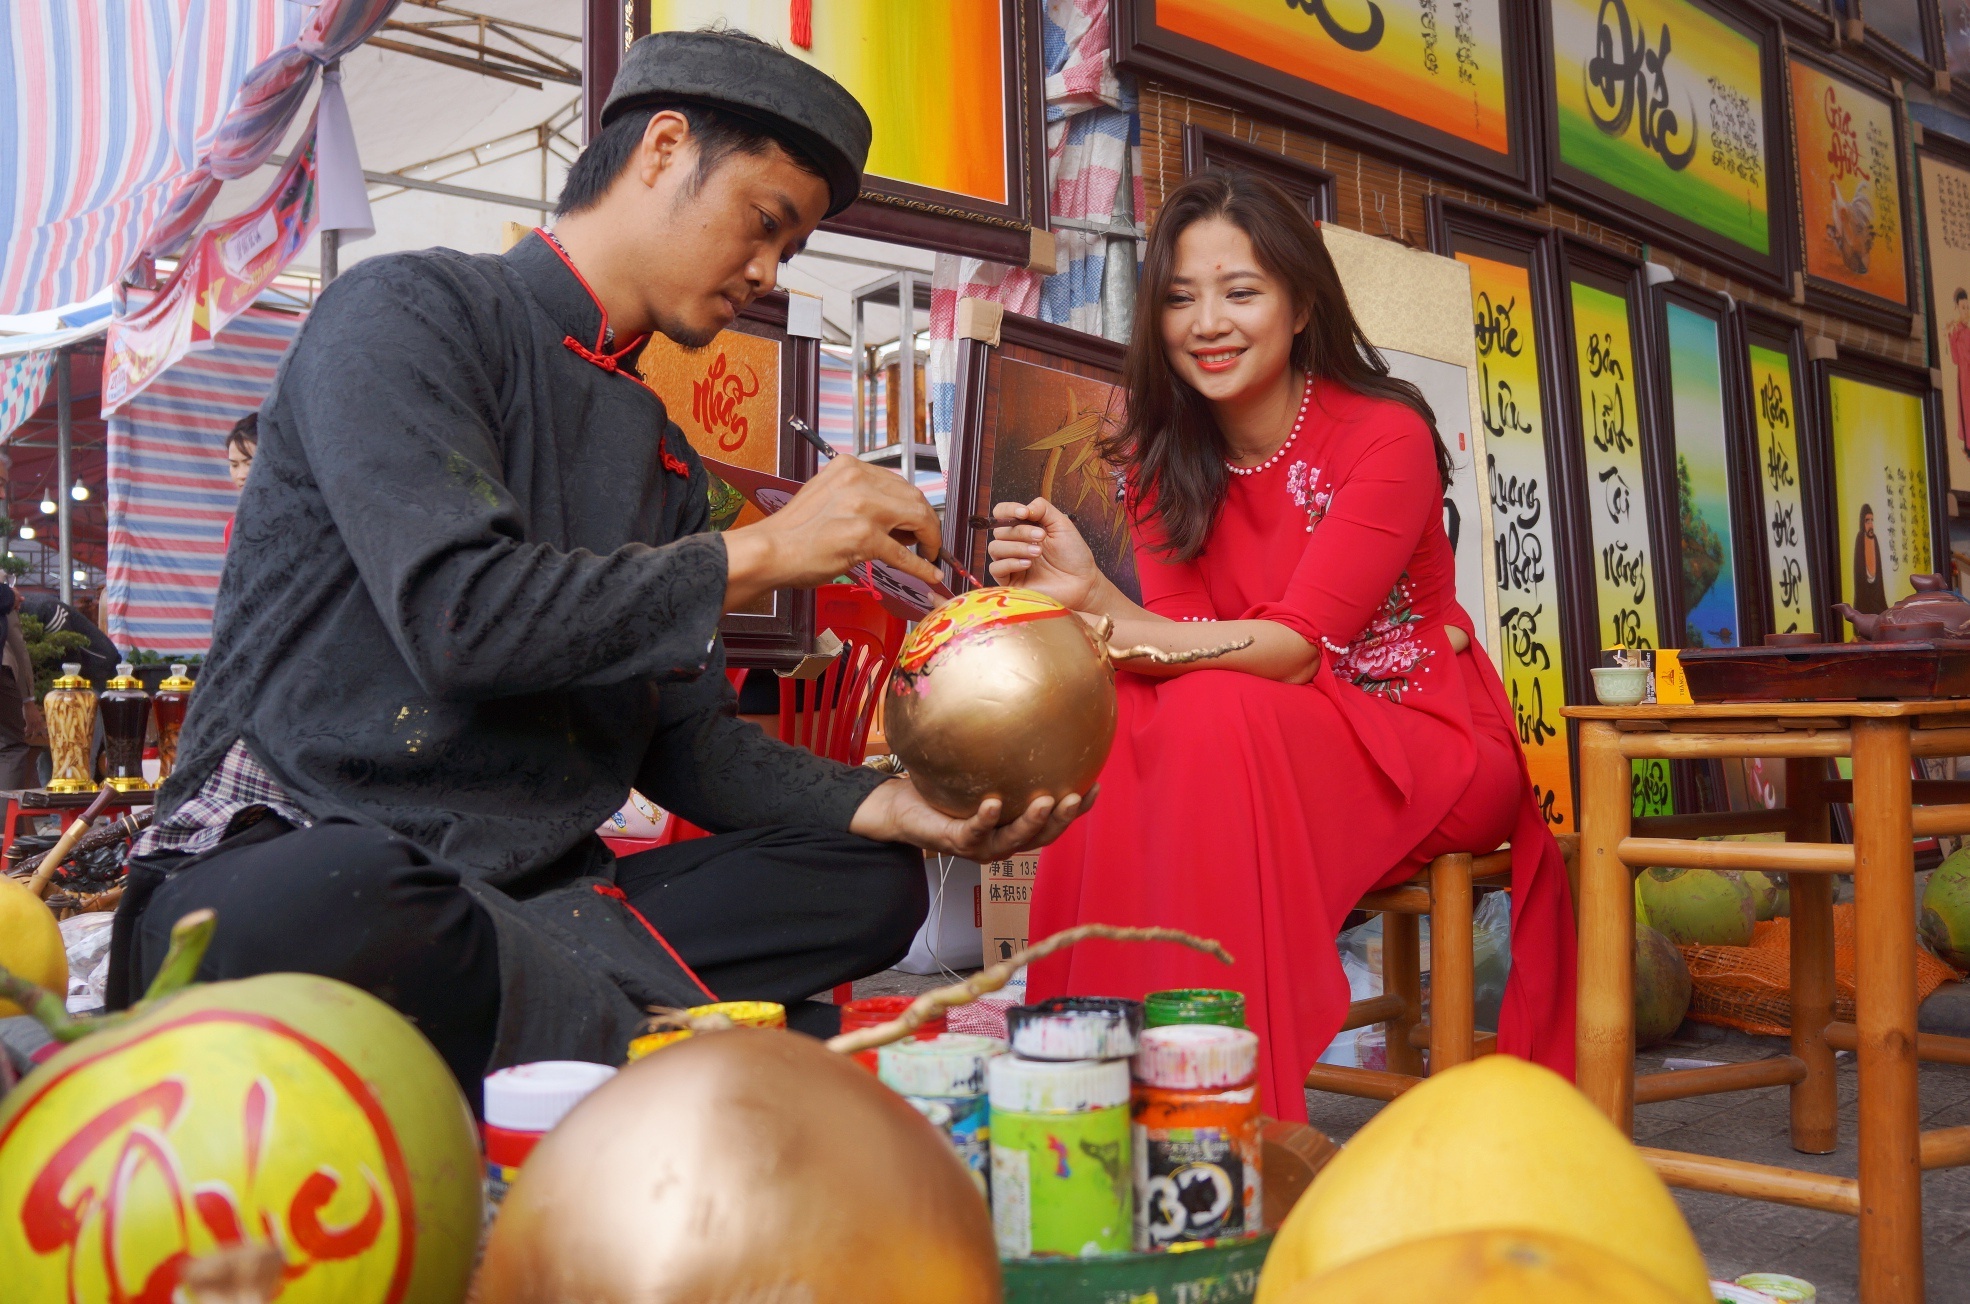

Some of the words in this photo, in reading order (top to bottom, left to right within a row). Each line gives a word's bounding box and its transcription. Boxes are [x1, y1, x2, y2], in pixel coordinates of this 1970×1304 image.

[1488, 454, 1540, 529] Quang
[1602, 540, 1645, 605] Năng
[989, 860, 1014, 877] 净重
